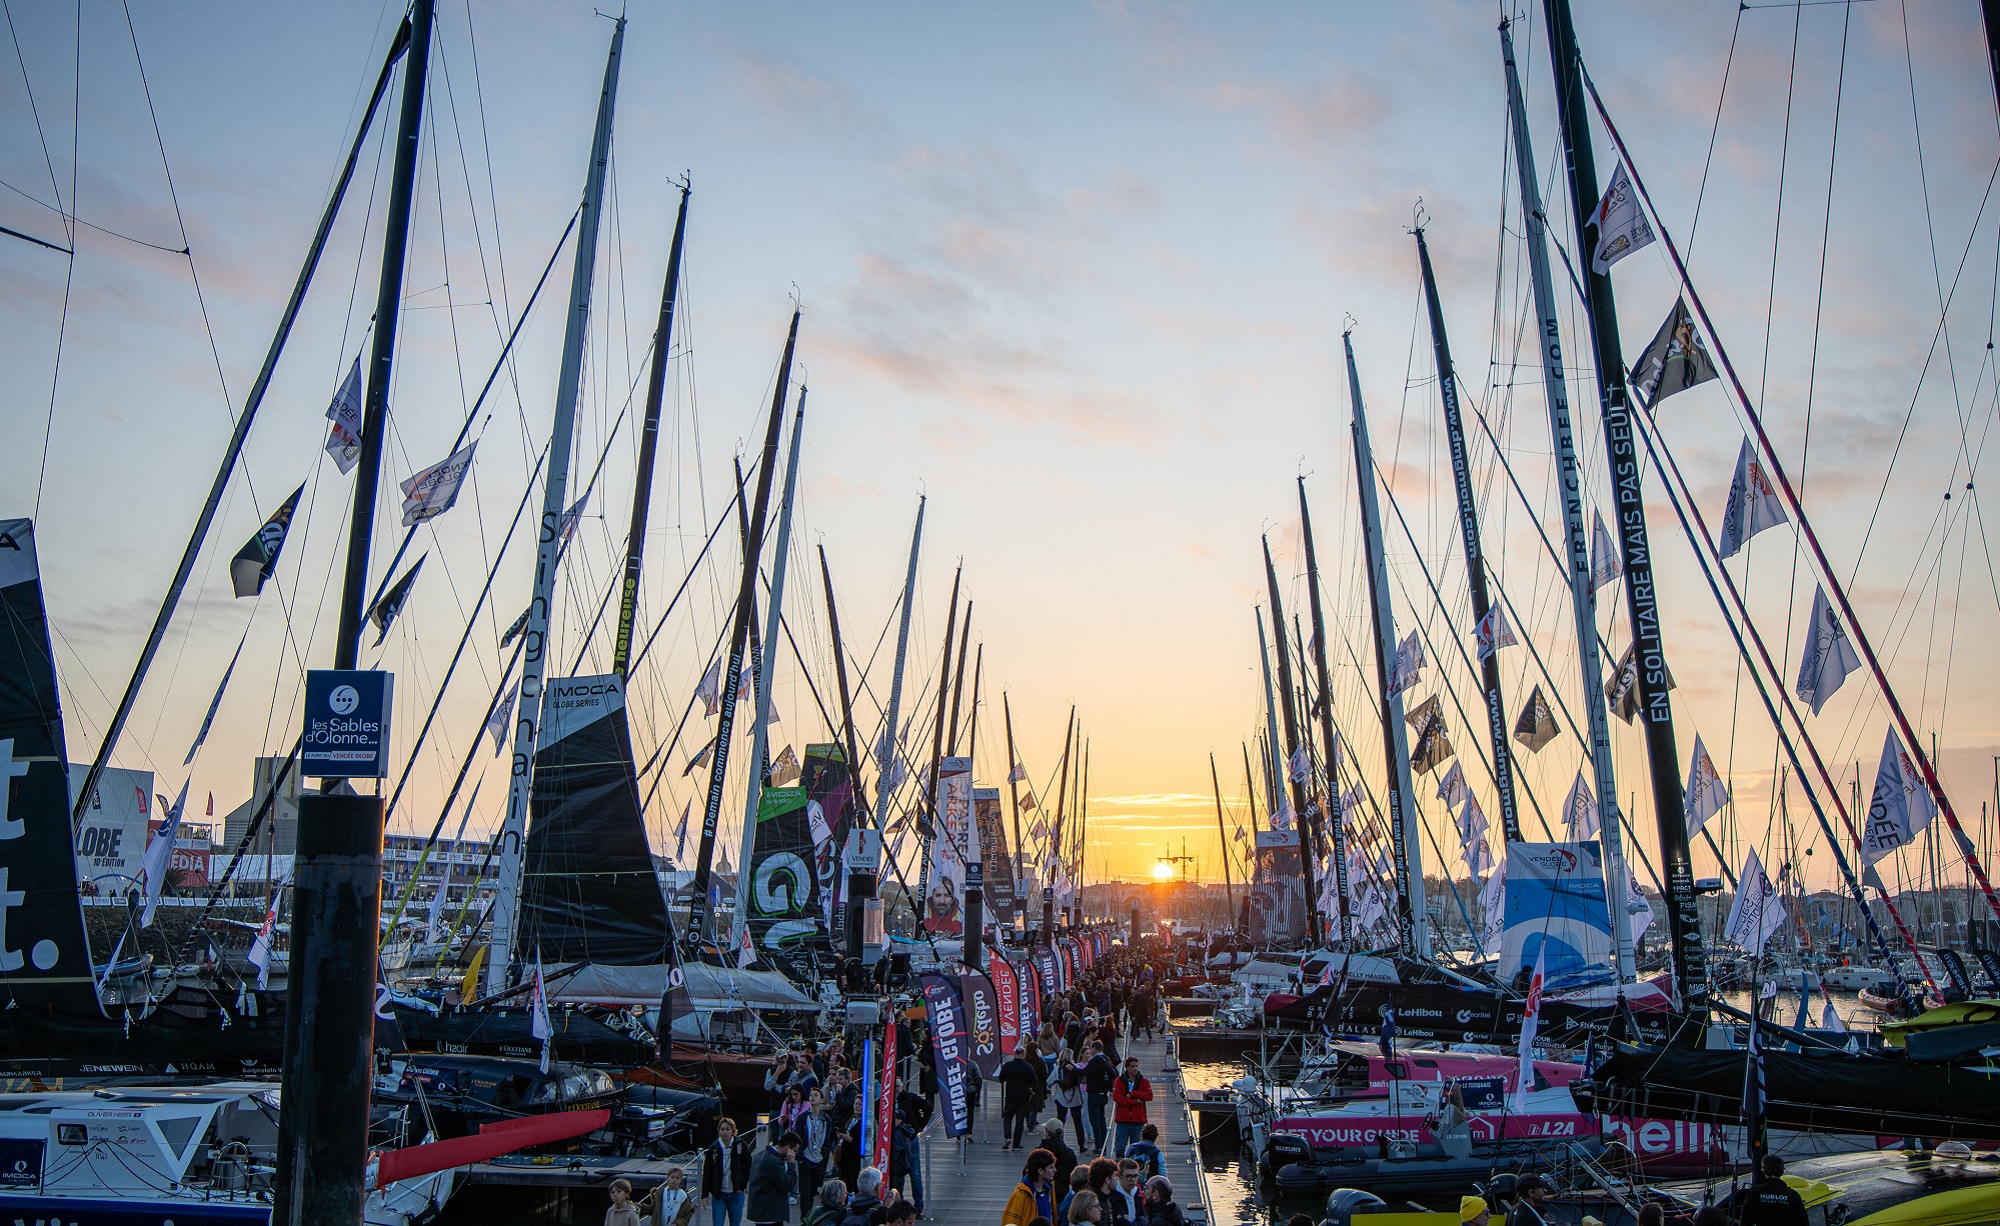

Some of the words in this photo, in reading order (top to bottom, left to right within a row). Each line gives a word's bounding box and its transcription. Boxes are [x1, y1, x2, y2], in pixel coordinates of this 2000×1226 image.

[1546, 317, 1590, 574] FRENCHBEE.COM
[1617, 464, 1639, 507] PAS
[615, 577, 636, 663] heureuse
[1633, 570, 1665, 685] SOLITAIRE
[552, 683, 620, 699] IMOCA
[724, 653, 741, 717] aujourd'hui
[552, 701, 574, 709] GLOBE
[575, 699, 600, 708] SERIES
[1649, 692, 1670, 722] EN
[312, 718, 328, 730] les
[330, 718, 379, 732] Sables
[305, 731, 378, 744] d'Olonne...
[333, 751, 354, 759] VENDÉE
[354, 751, 374, 759] GLOBE
[713, 717, 731, 776] commence
[1488, 688, 1518, 842] www.dmgmori.
[706, 777, 722, 829] Demain
[766, 790, 802, 799] IMOCA
[1330, 781, 1342, 817] EMBRACE
[1390, 789, 1399, 806] JOIN
[1392, 806, 1400, 820] THE
[1333, 817, 1343, 839] YOUR
[1393, 821, 1402, 841] TEAM
[76, 827, 123, 858] LOBE
[1395, 842, 1403, 857] FOR
[171, 855, 205, 872] ÉDIA
[1396, 857, 1404, 870] THE
[1529, 854, 1562, 862] VENDÉE
[1336, 840, 1348, 898] VULNERABILITY
[917, 867, 927, 902] PAPREC
[1397, 870, 1407, 897] PLANET
[1398, 1008, 1443, 1017] LeHibou
[1403, 1029, 1434, 1037] LeHibou
[445, 1041, 469, 1053] h2air
[80, 1064, 144, 1072] JENEWEIN
[181, 1062, 216, 1070] HQAM
[1310, 1128, 1362, 1143] YOUR
[1541, 1121, 1575, 1135] L2A
